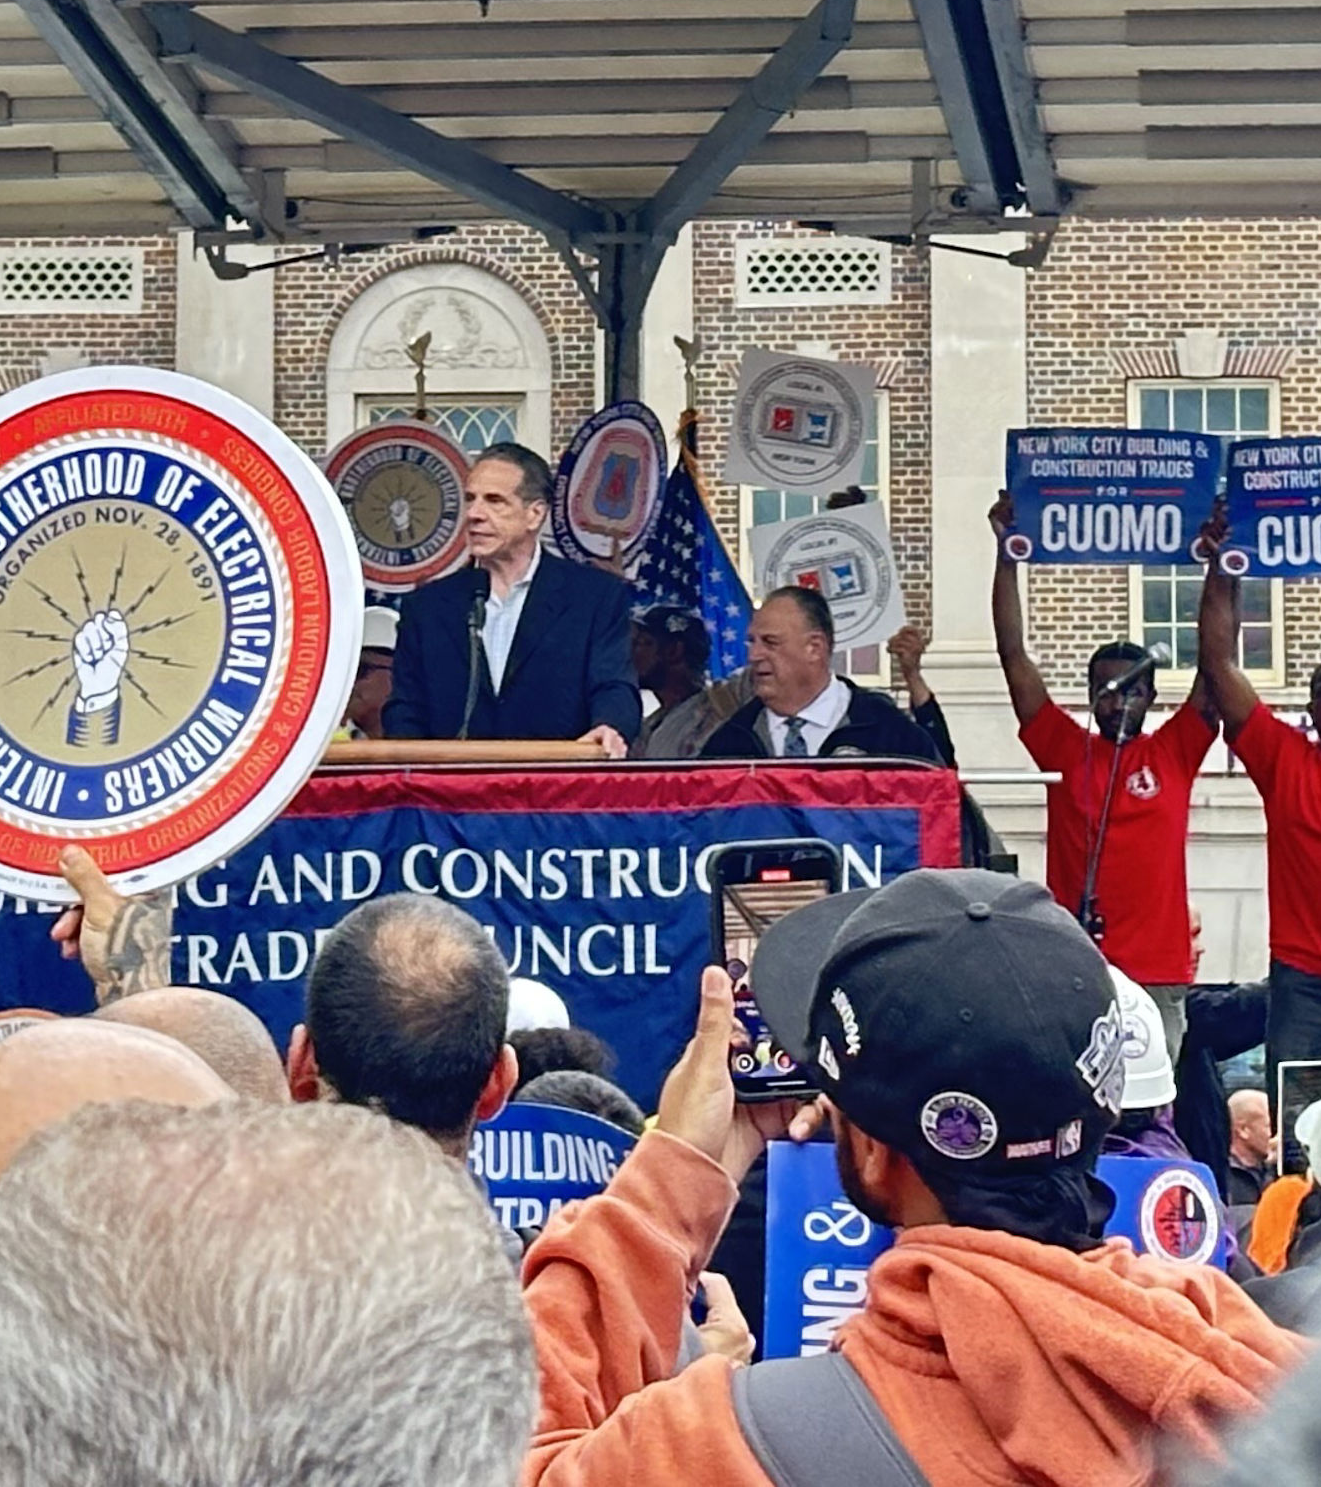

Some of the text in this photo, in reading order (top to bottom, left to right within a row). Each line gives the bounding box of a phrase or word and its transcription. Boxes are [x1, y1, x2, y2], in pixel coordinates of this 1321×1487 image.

[33, 401, 188, 436] AFFILIATED WITH
[1018, 436, 1209, 458] NEW YORK CITY BUILDING &
[1031, 459, 1194, 479] CONSTRUCTION TRADES
[1233, 448, 1260, 467] NEW
[1263, 445, 1300, 466] YORK
[154, 465, 202, 513] OF
[219, 437, 297, 526] CONGRESS
[1096, 486, 1128, 496] FOR
[1041, 503, 1182, 553] CUOMO
[95, 506, 147, 530] NOV.
[154, 521, 182, 554] 28,
[185, 551, 217, 603] 1891
[288, 522, 321, 609] LABOUR
[193, 496, 272, 687] ELECTRICAL
[282, 614, 321, 717] CANADIAN
[273, 721, 292, 738] &
[104, 698, 245, 813] WORKERS
[147, 738, 278, 852] ORGANIZATIONS
[28, 840, 143, 865] INDTRIAL
[249, 848, 383, 906] AND
[402, 842, 882, 901] CONSTRUCN
[169, 923, 671, 985] RAD UNCIL
[804, 1201, 872, 1247] &
